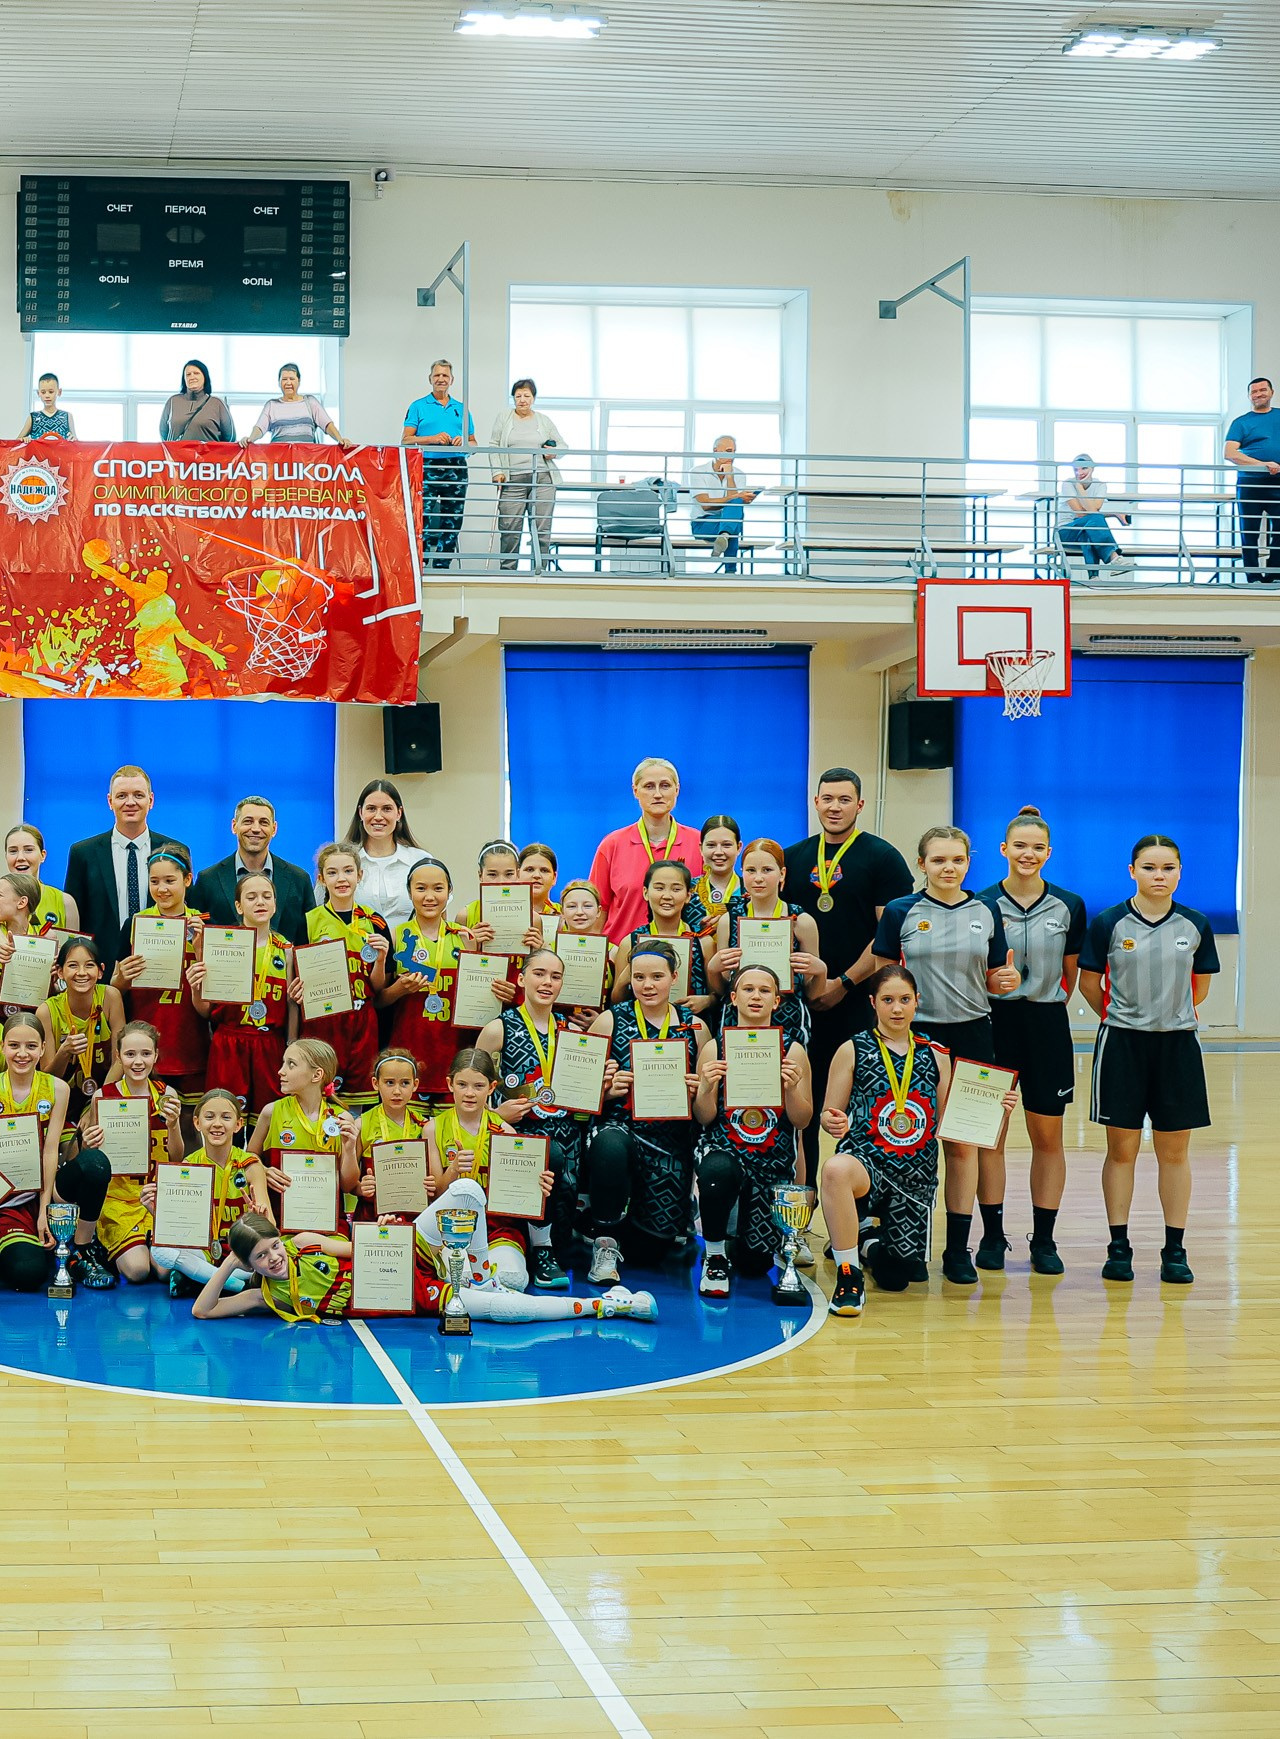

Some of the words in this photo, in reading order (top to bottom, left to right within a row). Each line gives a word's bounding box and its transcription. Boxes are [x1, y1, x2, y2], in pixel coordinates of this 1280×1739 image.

[106, 204, 133, 213] СЧЕТ
[164, 205, 206, 215] ПЕРИОД
[253, 206, 279, 216] СЧЕТ
[168, 260, 204, 268] ВРЕМЯ
[98, 275, 129, 284] ФОЛЫ
[242, 277, 273, 286] ФОЛЫ
[93, 459, 268, 481] СПОРТИВНАЯ
[276, 463, 364, 485] ШКОЛА
[10, 484, 56, 496] НАДЕЖДА
[93, 483, 248, 502] ОЛИМПИЙСКОГО
[252, 488, 334, 504] РЕЗЕРВА
[94, 504, 121, 517] ПО
[125, 504, 247, 520] БАСКЕТБОЛУ
[252, 506, 366, 522] «НАДЕЖДА»
[142, 938, 176, 946] ДИПЛОМ
[211, 949, 245, 958] ДИПЛОМ
[14, 954, 46, 964] ДИПЛОМ
[565, 954, 597, 963] ДИПЛОМ
[563, 1053, 597, 1064] ДИПЛОМ
[734, 1051, 771, 1060] ДИПЛОМ
[642, 1062, 678, 1071] ДИПЛОМ
[960, 1085, 999, 1100] ДИПЛОМ
[107, 1120, 141, 1129] ДИПЛОМ
[382, 1162, 418, 1172] ДИПЛОМ
[500, 1158, 536, 1168] ДИПЛОМ
[166, 1188, 202, 1197] ДИПЛОМ
[364, 1249, 403, 1258] ДИПЛОМ
